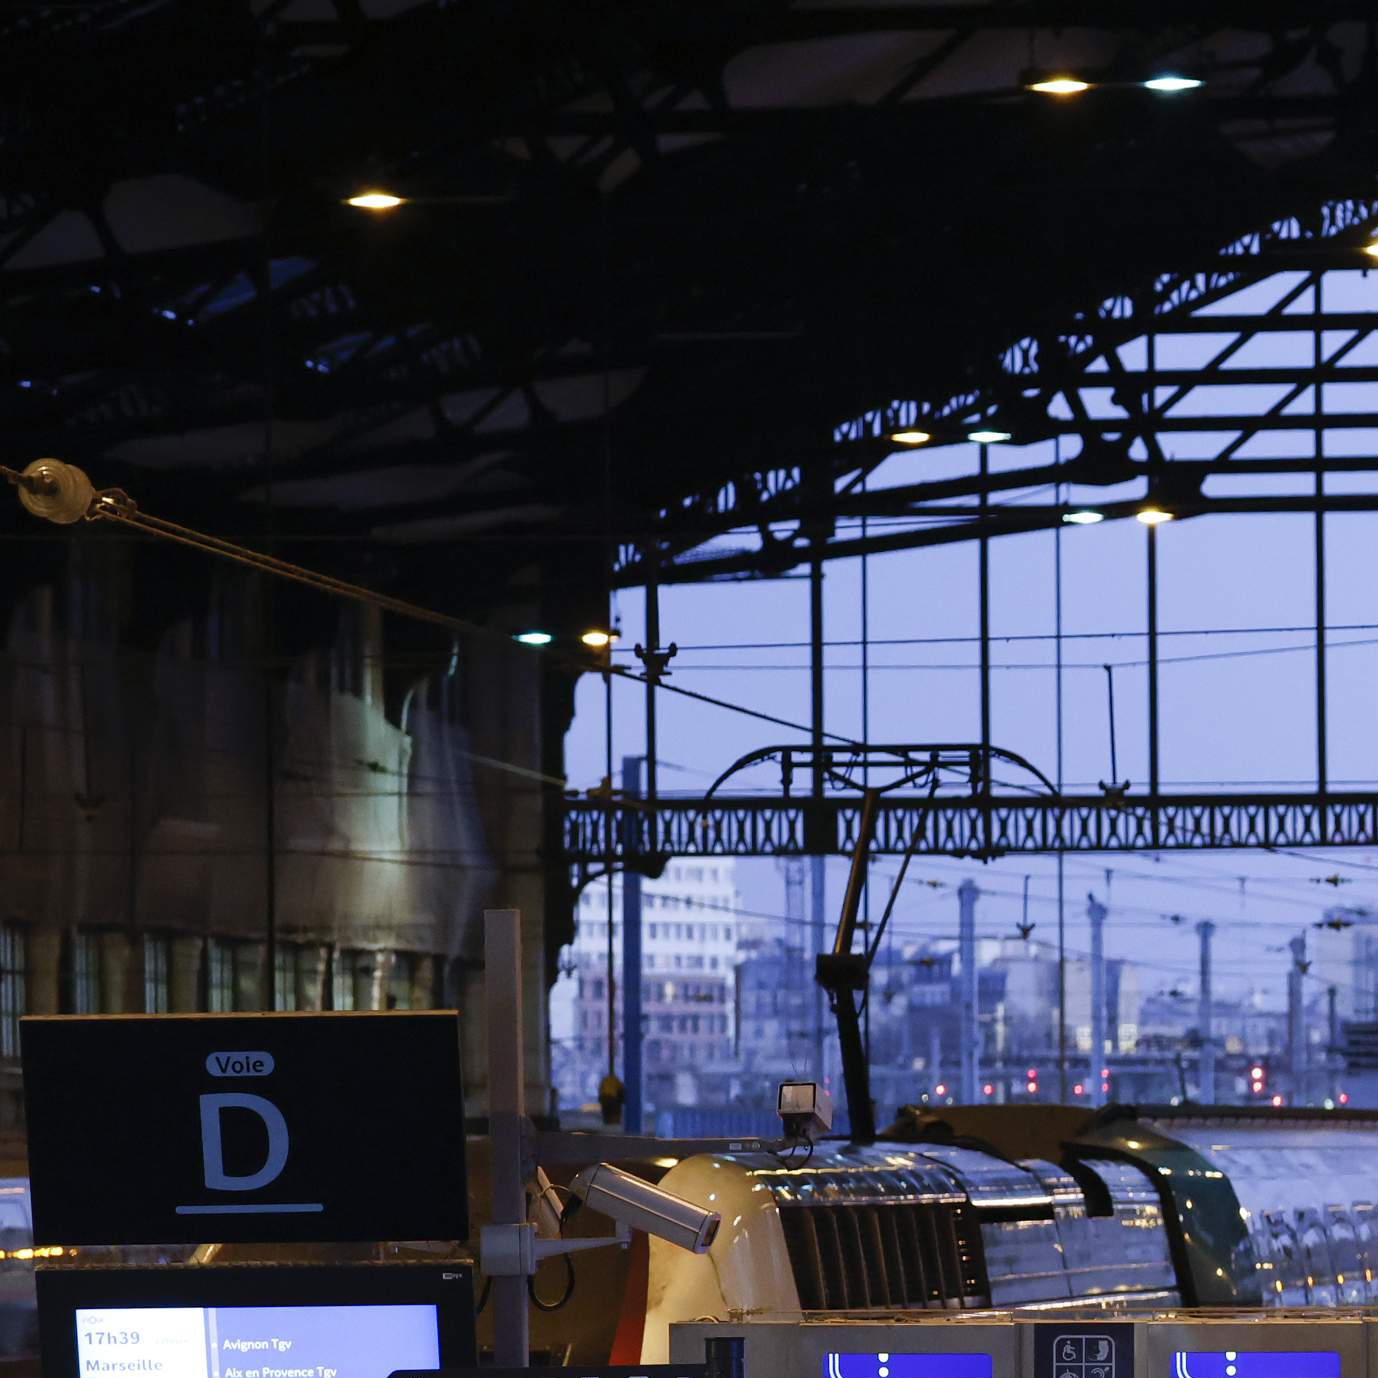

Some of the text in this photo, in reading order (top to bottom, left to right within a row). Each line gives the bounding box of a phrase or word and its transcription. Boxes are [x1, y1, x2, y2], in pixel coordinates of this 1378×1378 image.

[216, 1054, 264, 1074] Voie
[200, 1092, 289, 1191] D
[84, 1331, 141, 1346] 17h39
[223, 1338, 292, 1351] Avignon Tgv
[86, 1359, 163, 1372] Marseille
[225, 1366, 337, 1378] Aix en Provence Tgv
